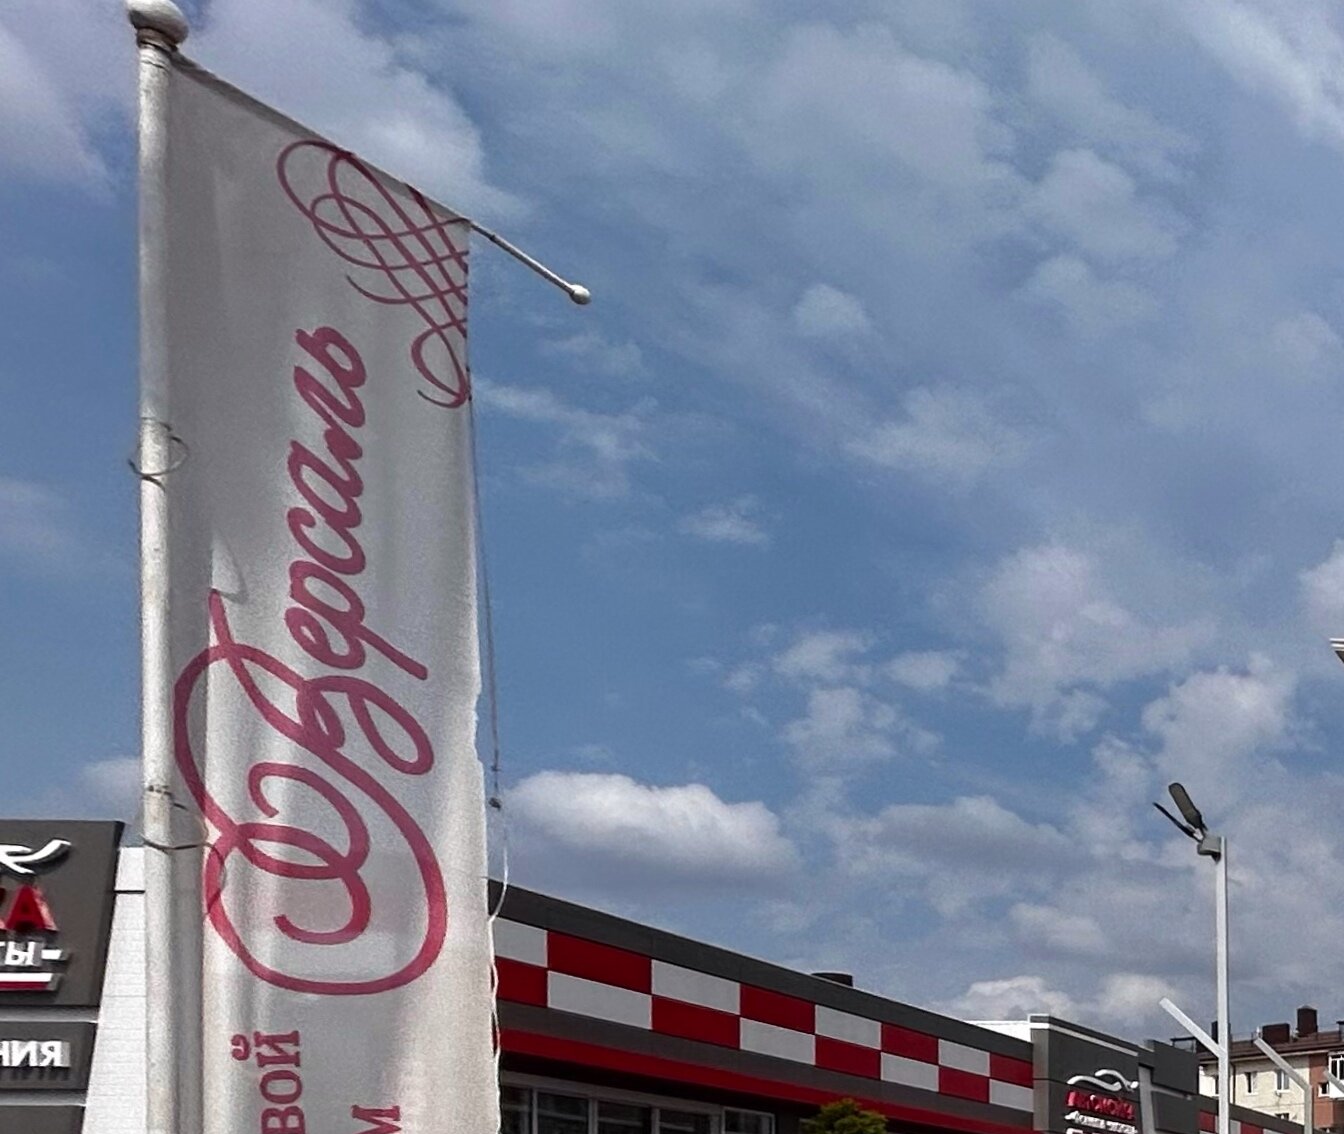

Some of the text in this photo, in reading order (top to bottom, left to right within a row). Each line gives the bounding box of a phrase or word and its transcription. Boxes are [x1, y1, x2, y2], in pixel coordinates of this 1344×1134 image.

[173, 325, 447, 996] Версаль
[0, 884, 58, 932] А
[0, 941, 62, 967] Ы-
